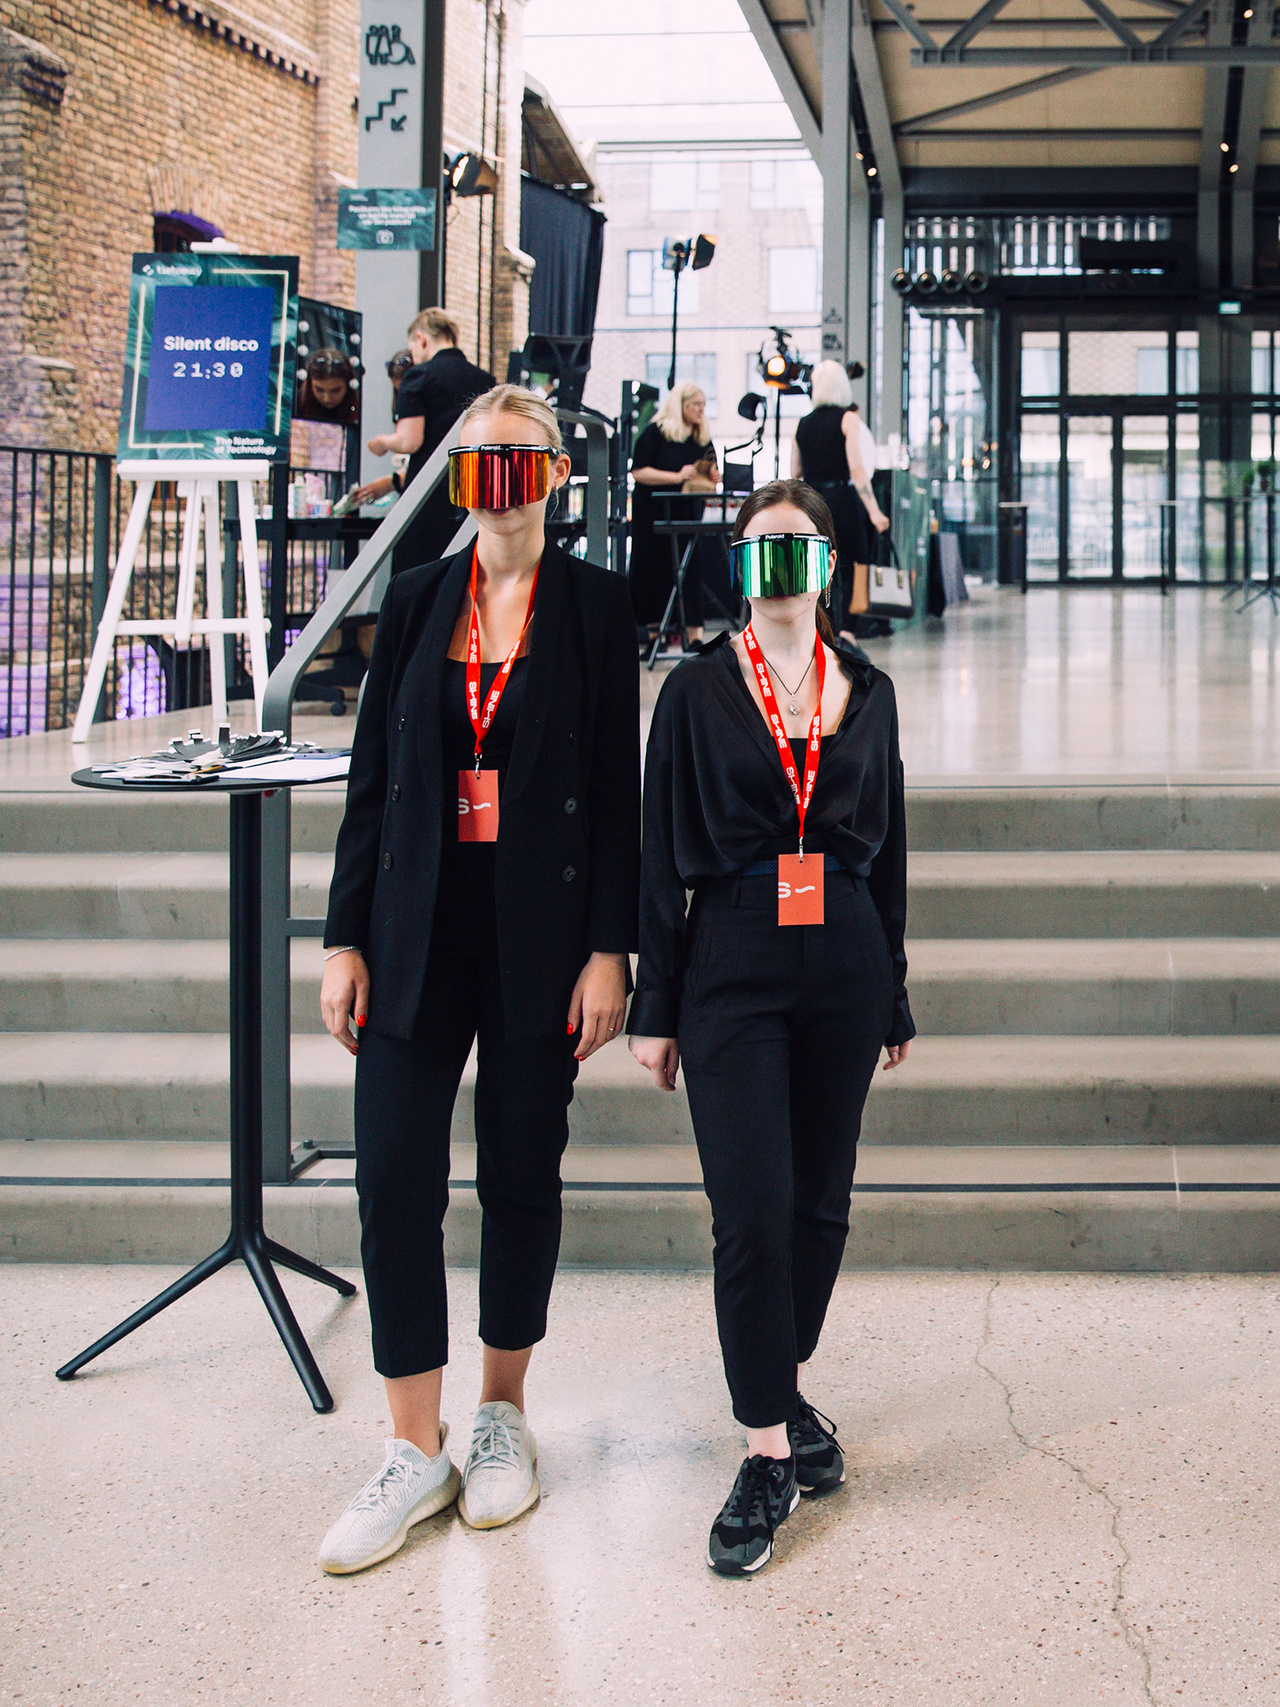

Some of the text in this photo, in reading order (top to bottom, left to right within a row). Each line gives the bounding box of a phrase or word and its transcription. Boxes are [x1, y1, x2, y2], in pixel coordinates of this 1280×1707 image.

[163, 335, 259, 351] Silent disco
[469, 628, 478, 664] SHINE
[756, 662, 772, 698] SHINE
[468, 681, 478, 720] SHINE
[481, 690, 501, 729] SHINE
[770, 713, 788, 749] SHINE
[810, 715, 820, 752] SHINE
[803, 769, 816, 809] SHINE
